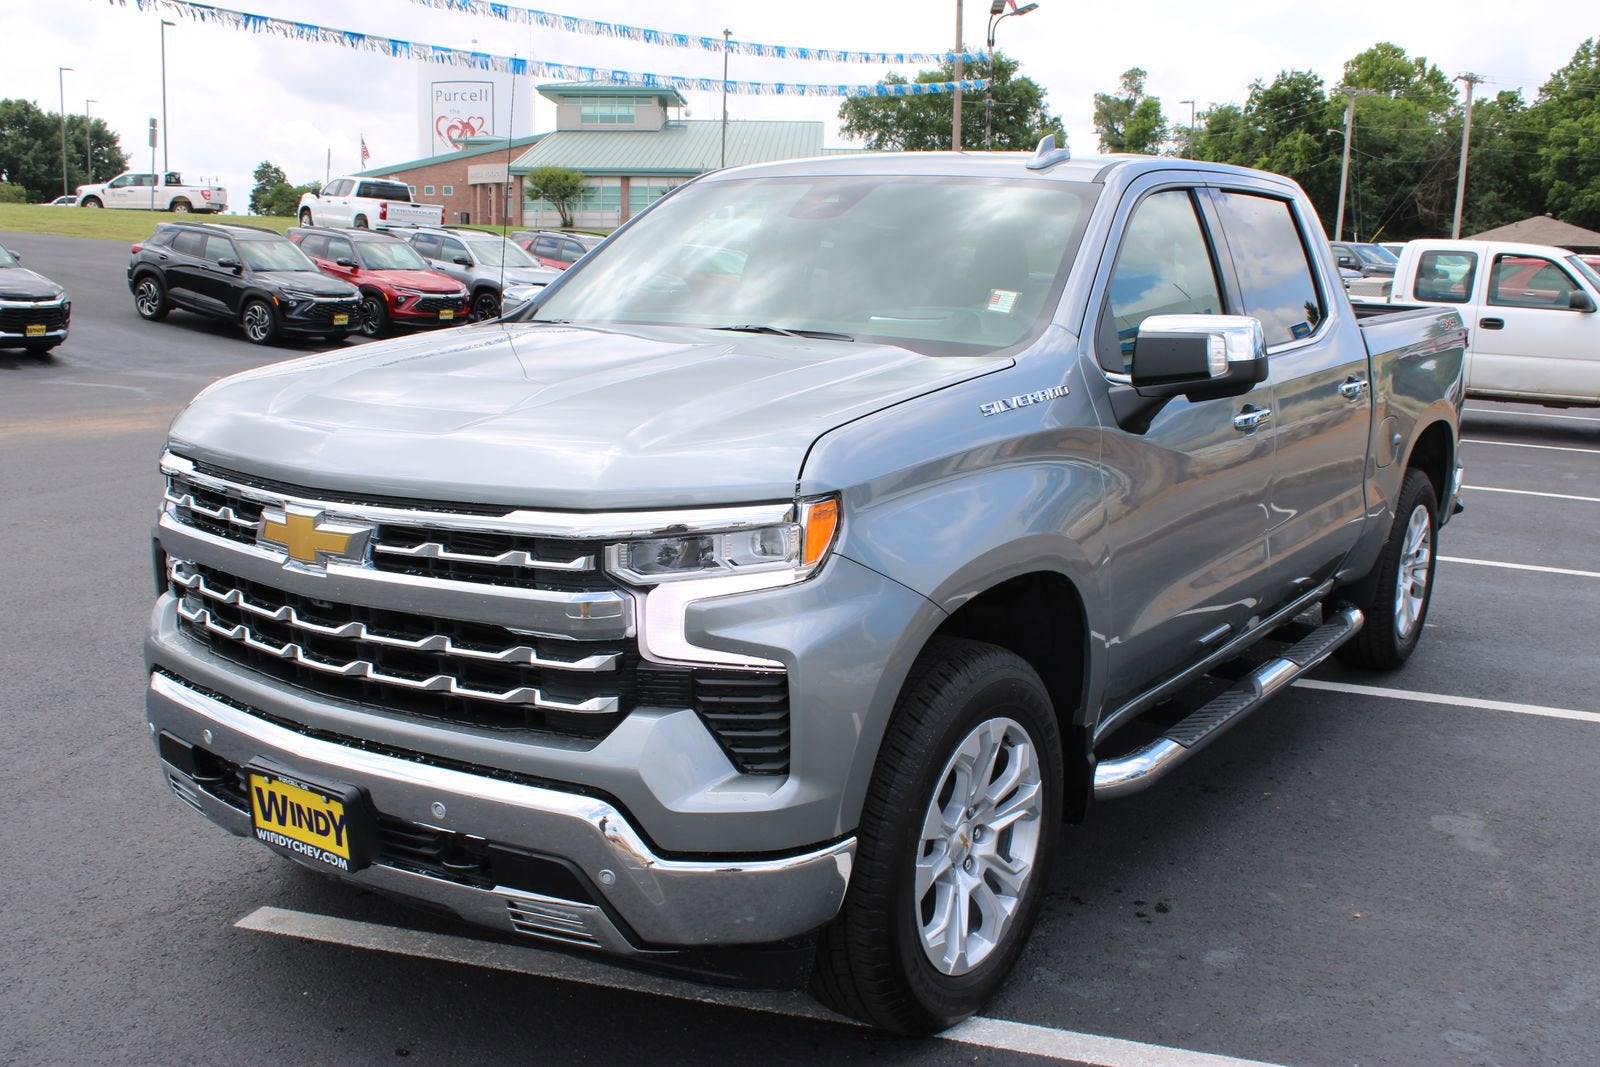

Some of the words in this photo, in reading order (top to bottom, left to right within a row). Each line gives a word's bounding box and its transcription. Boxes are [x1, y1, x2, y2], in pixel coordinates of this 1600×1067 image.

[435, 89, 489, 102] Purcell
[980, 385, 1070, 416] SILVERADO
[255, 786, 346, 847] WINDY
[256, 828, 349, 871] WINDYCHEV.COM
